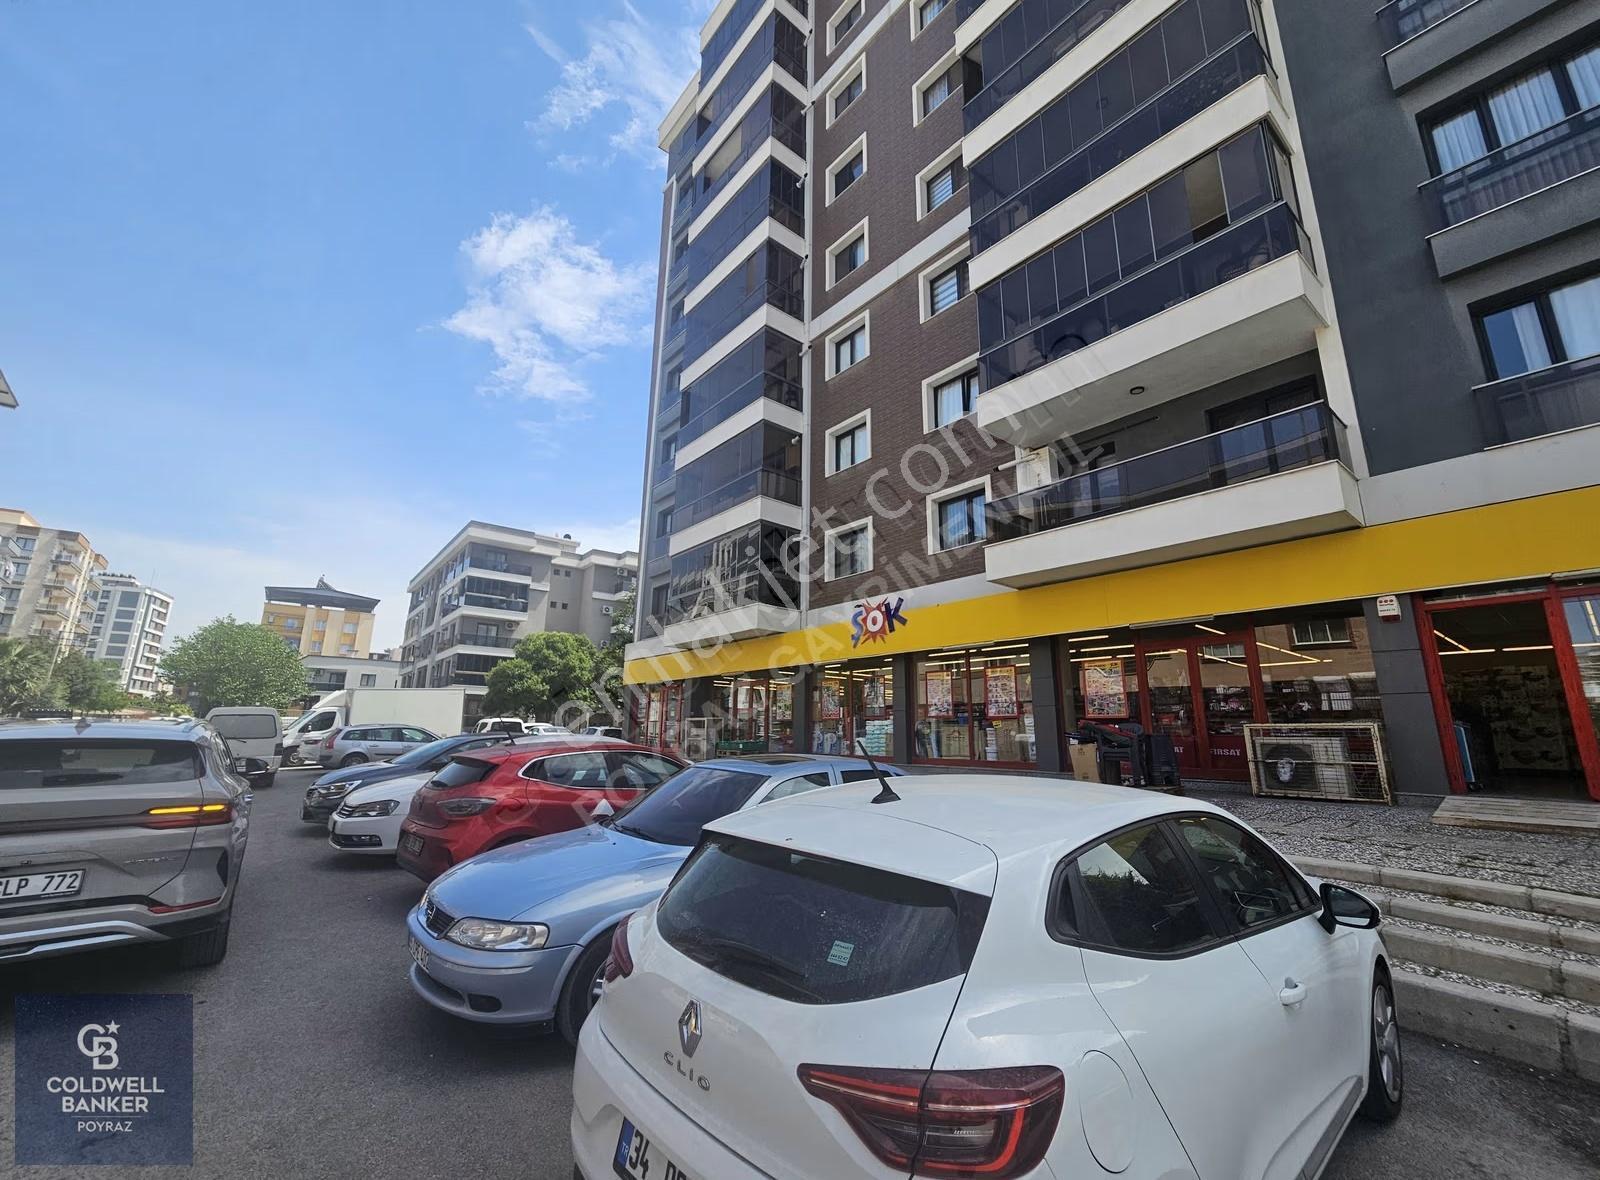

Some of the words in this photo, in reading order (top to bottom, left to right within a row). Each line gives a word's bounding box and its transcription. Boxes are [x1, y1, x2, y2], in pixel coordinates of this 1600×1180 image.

[41, 873, 79, 892] 772
[664, 1050, 710, 1091] CLIO
[622, 1142, 629, 1156] TR
[628, 1129, 650, 1180] 34
